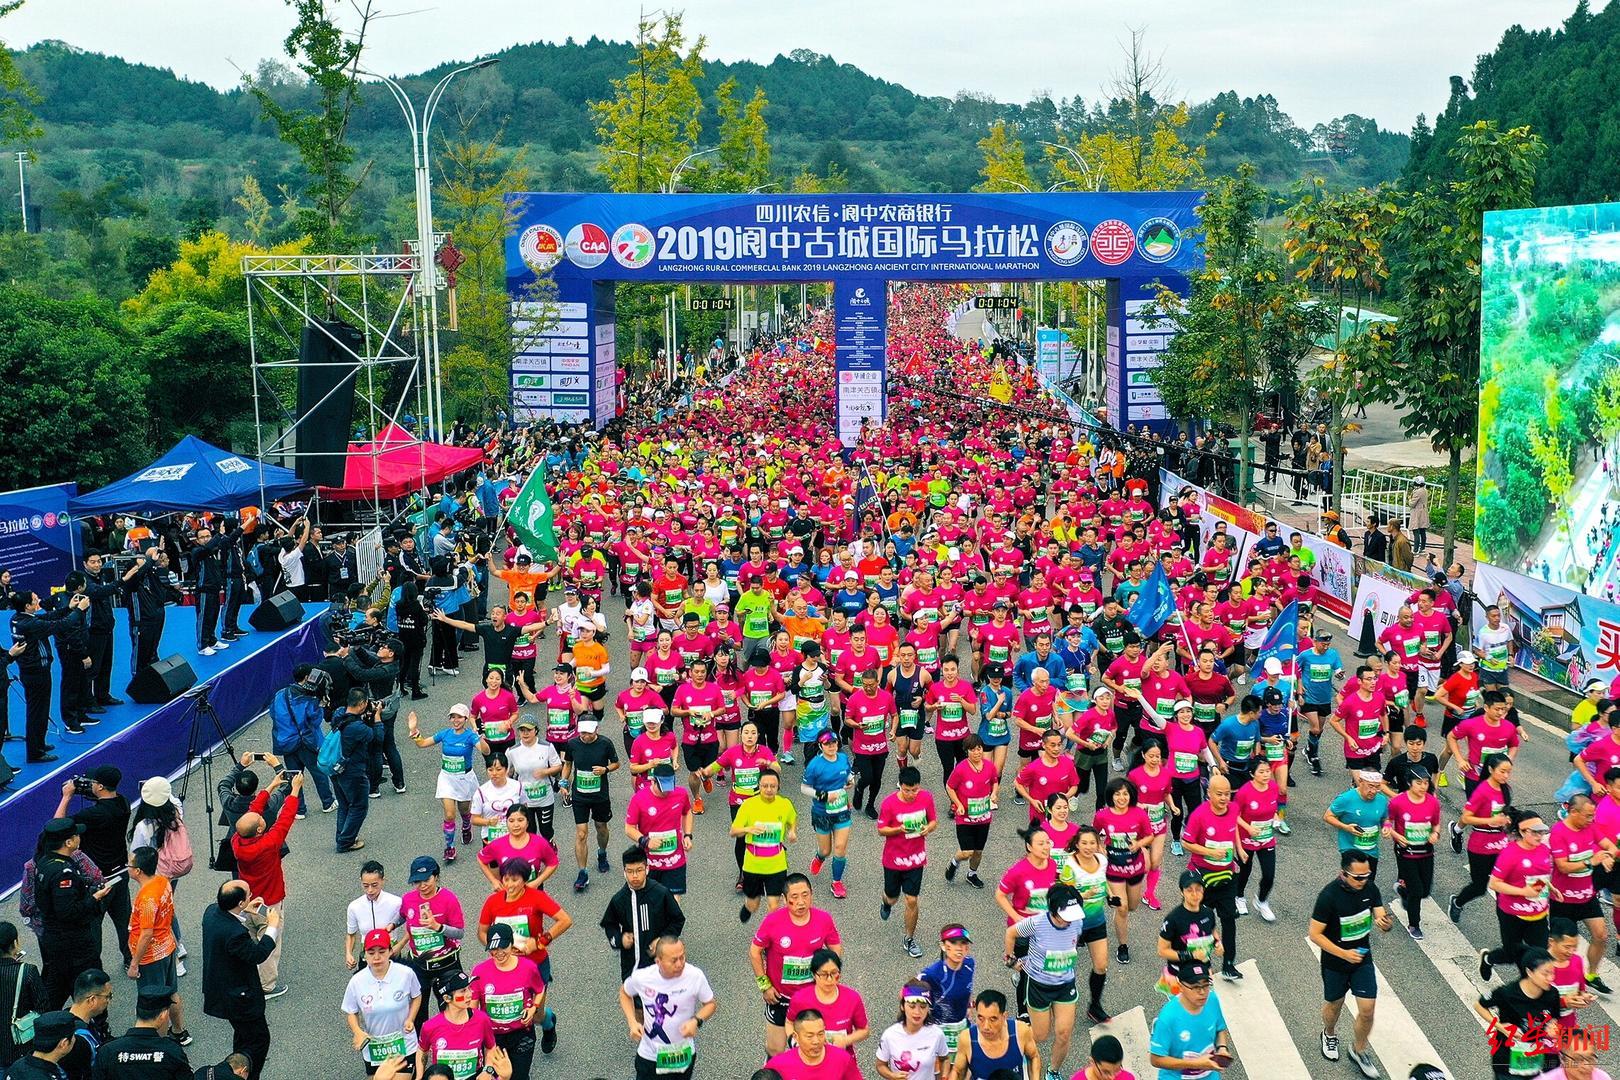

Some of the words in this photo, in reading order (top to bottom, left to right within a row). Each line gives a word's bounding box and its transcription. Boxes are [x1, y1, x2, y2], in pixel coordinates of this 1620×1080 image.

[756, 204, 952, 223] 四川农信·阆中农商银行
[582, 241, 607, 251] CAA
[657, 224, 1039, 262] 2019阆中古城国际马拉松
[658, 264, 705, 272] LANGZHONG
[705, 264, 730, 272] RURAL
[781, 264, 802, 272] BANK
[803, 263, 821, 272] 2019
[822, 263, 873, 271] LANGZHONG
[874, 263, 909, 271] ANCIENT
[910, 263, 929, 271] CITY
[995, 262, 1039, 270] MARATHON
[118, 1052, 128, 1063] 特
[129, 1053, 152, 1061] SWAT
[153, 1051, 164, 1063] 警
